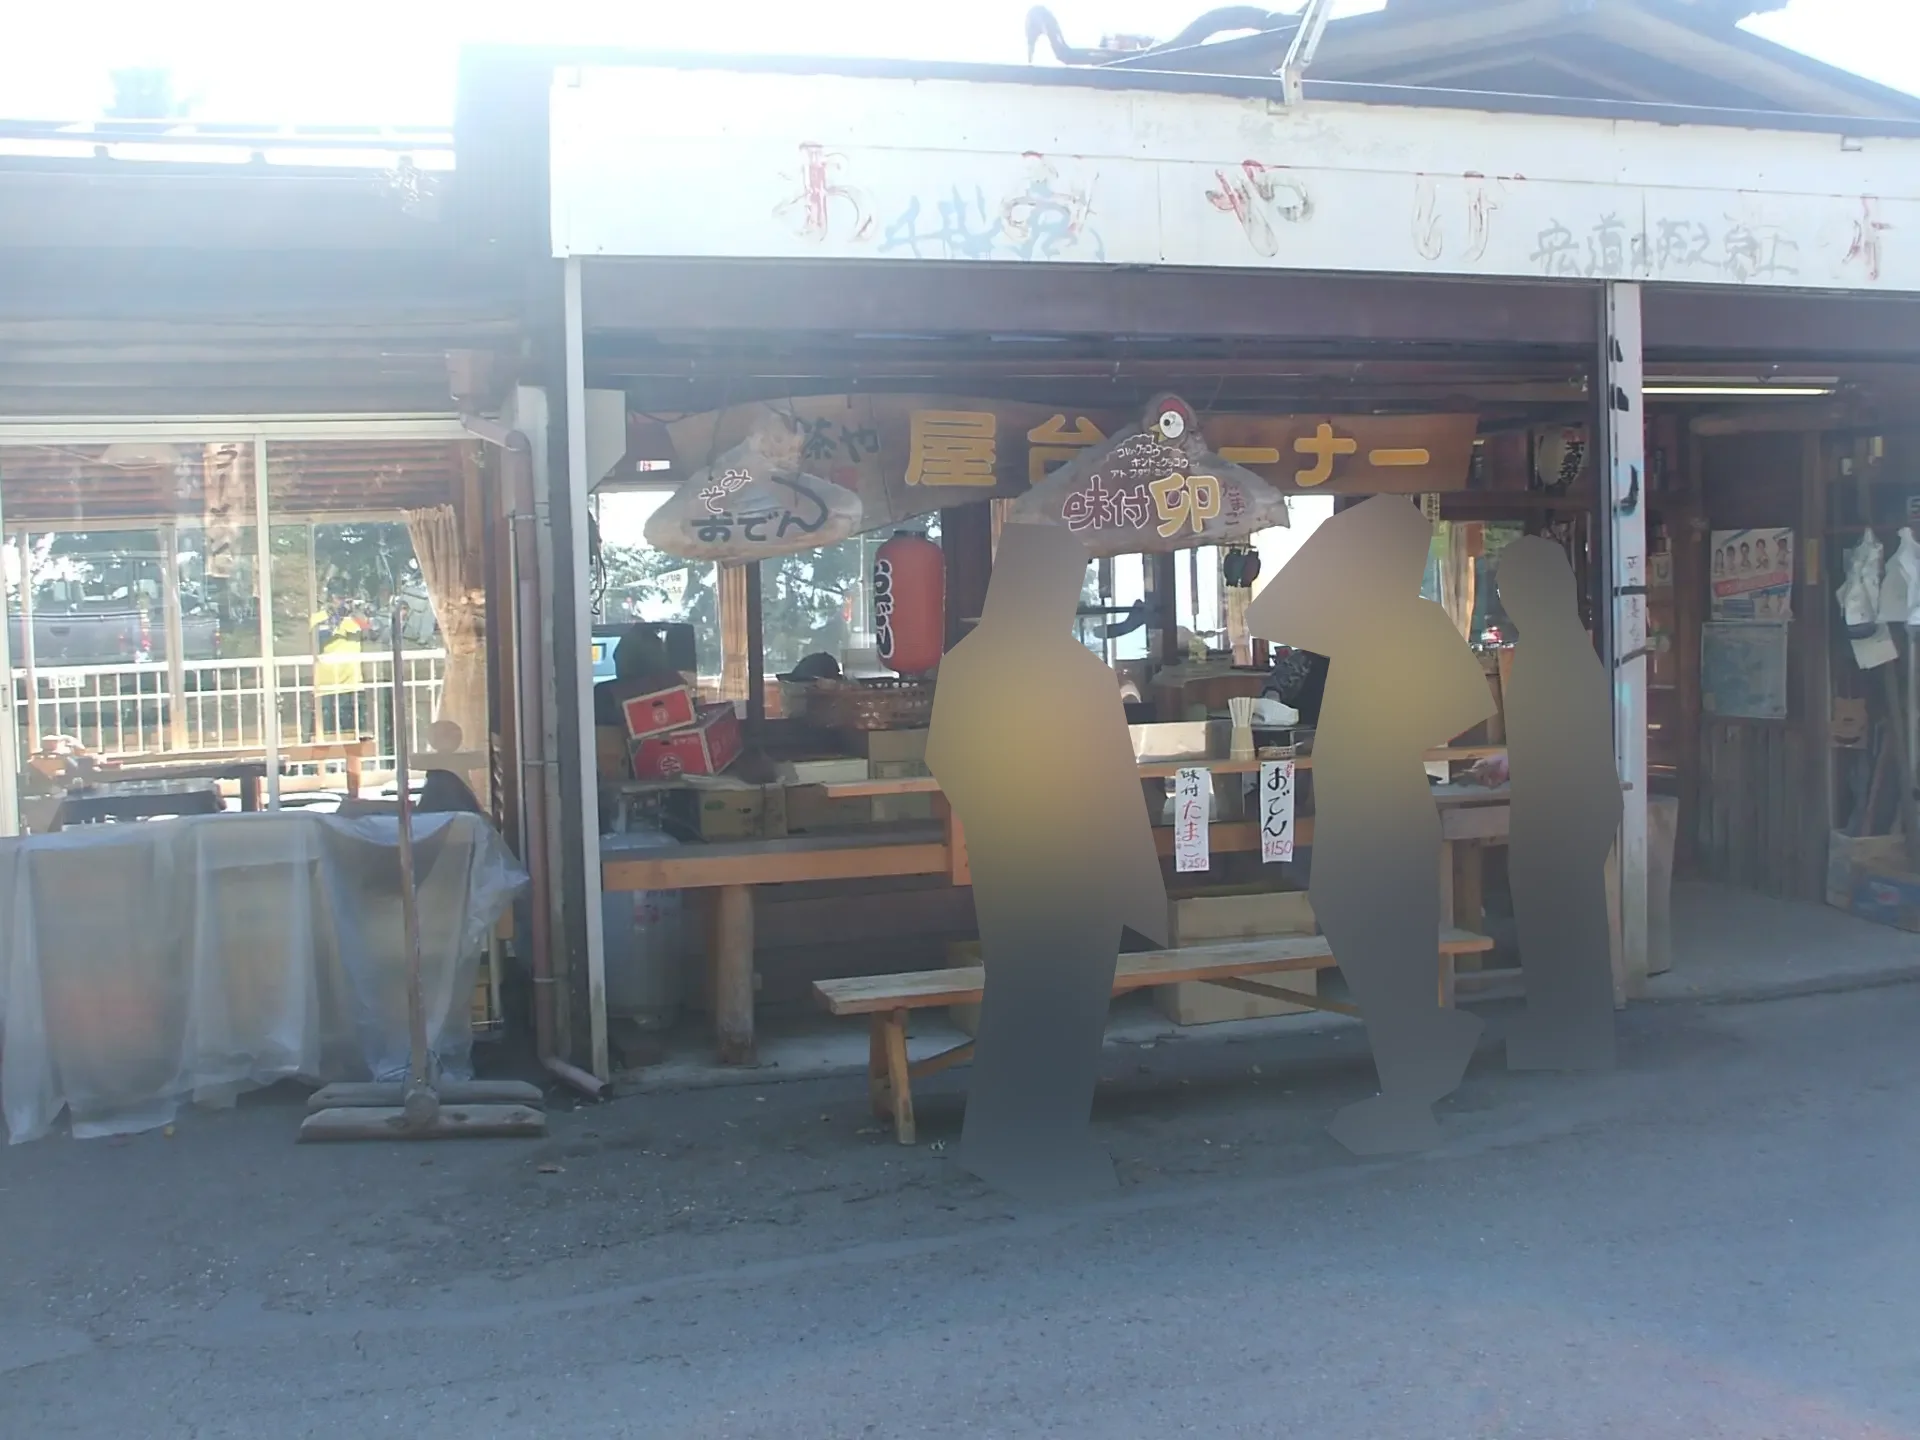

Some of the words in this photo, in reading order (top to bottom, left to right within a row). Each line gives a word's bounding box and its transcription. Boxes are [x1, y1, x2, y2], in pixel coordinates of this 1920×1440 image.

[691, 474, 829, 542] おでん
[1263, 766, 1291, 837] おでん
